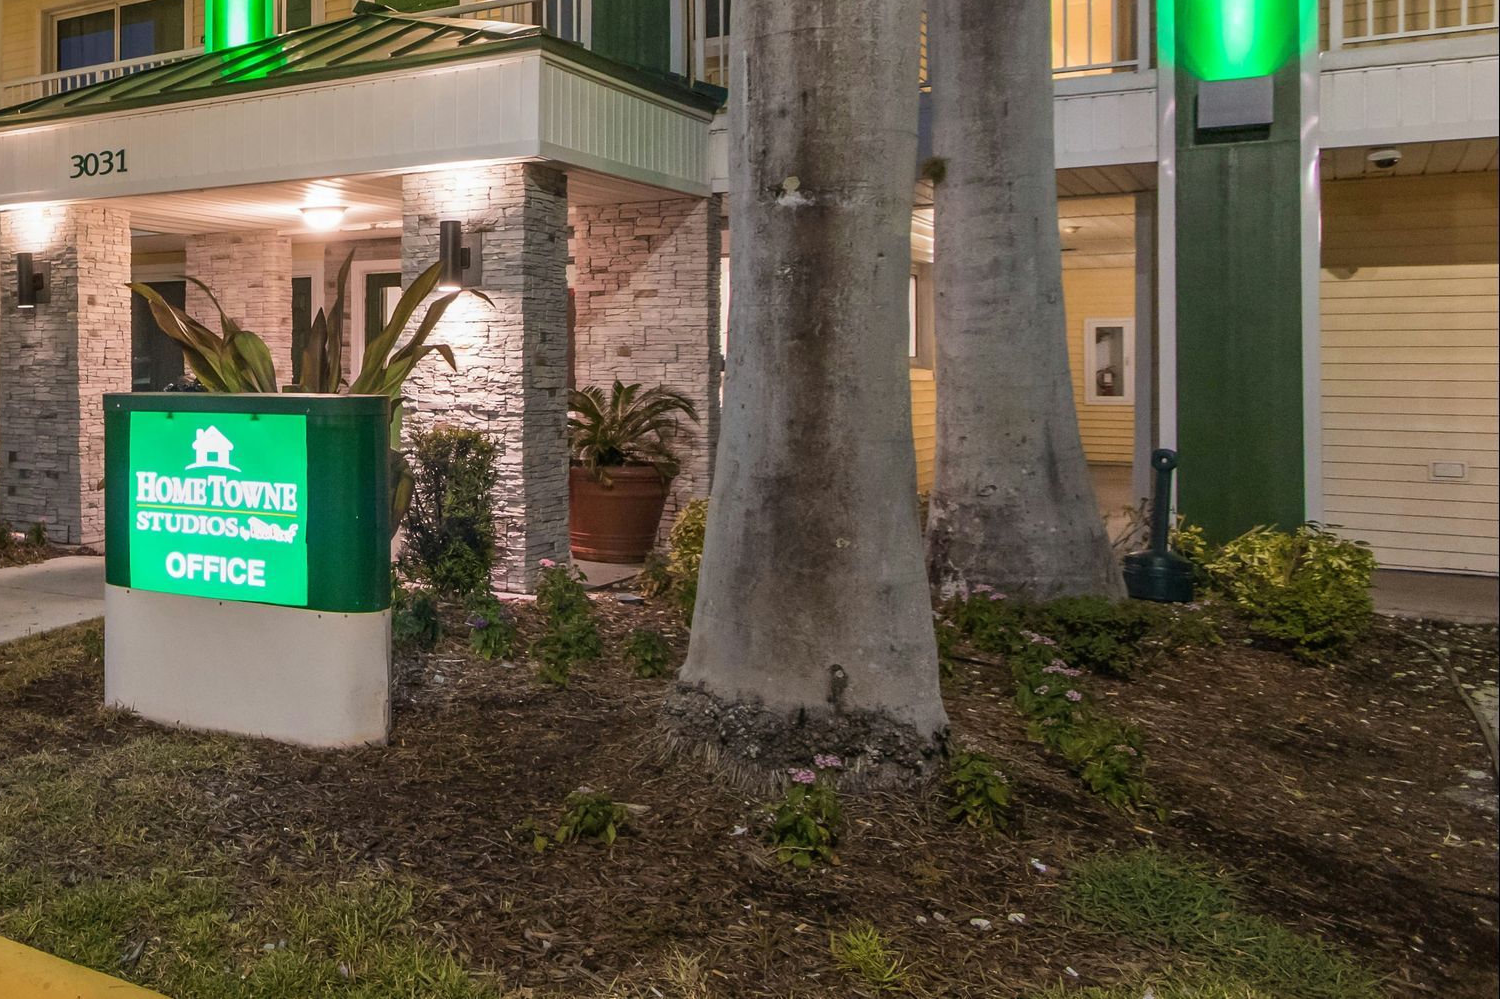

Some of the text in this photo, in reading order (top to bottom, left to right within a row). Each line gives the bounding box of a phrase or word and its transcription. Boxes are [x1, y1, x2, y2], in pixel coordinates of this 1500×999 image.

[70, 149, 128, 178] 3031
[136, 511, 239, 537] STUDIOS
[165, 551, 266, 587] OFFICE
